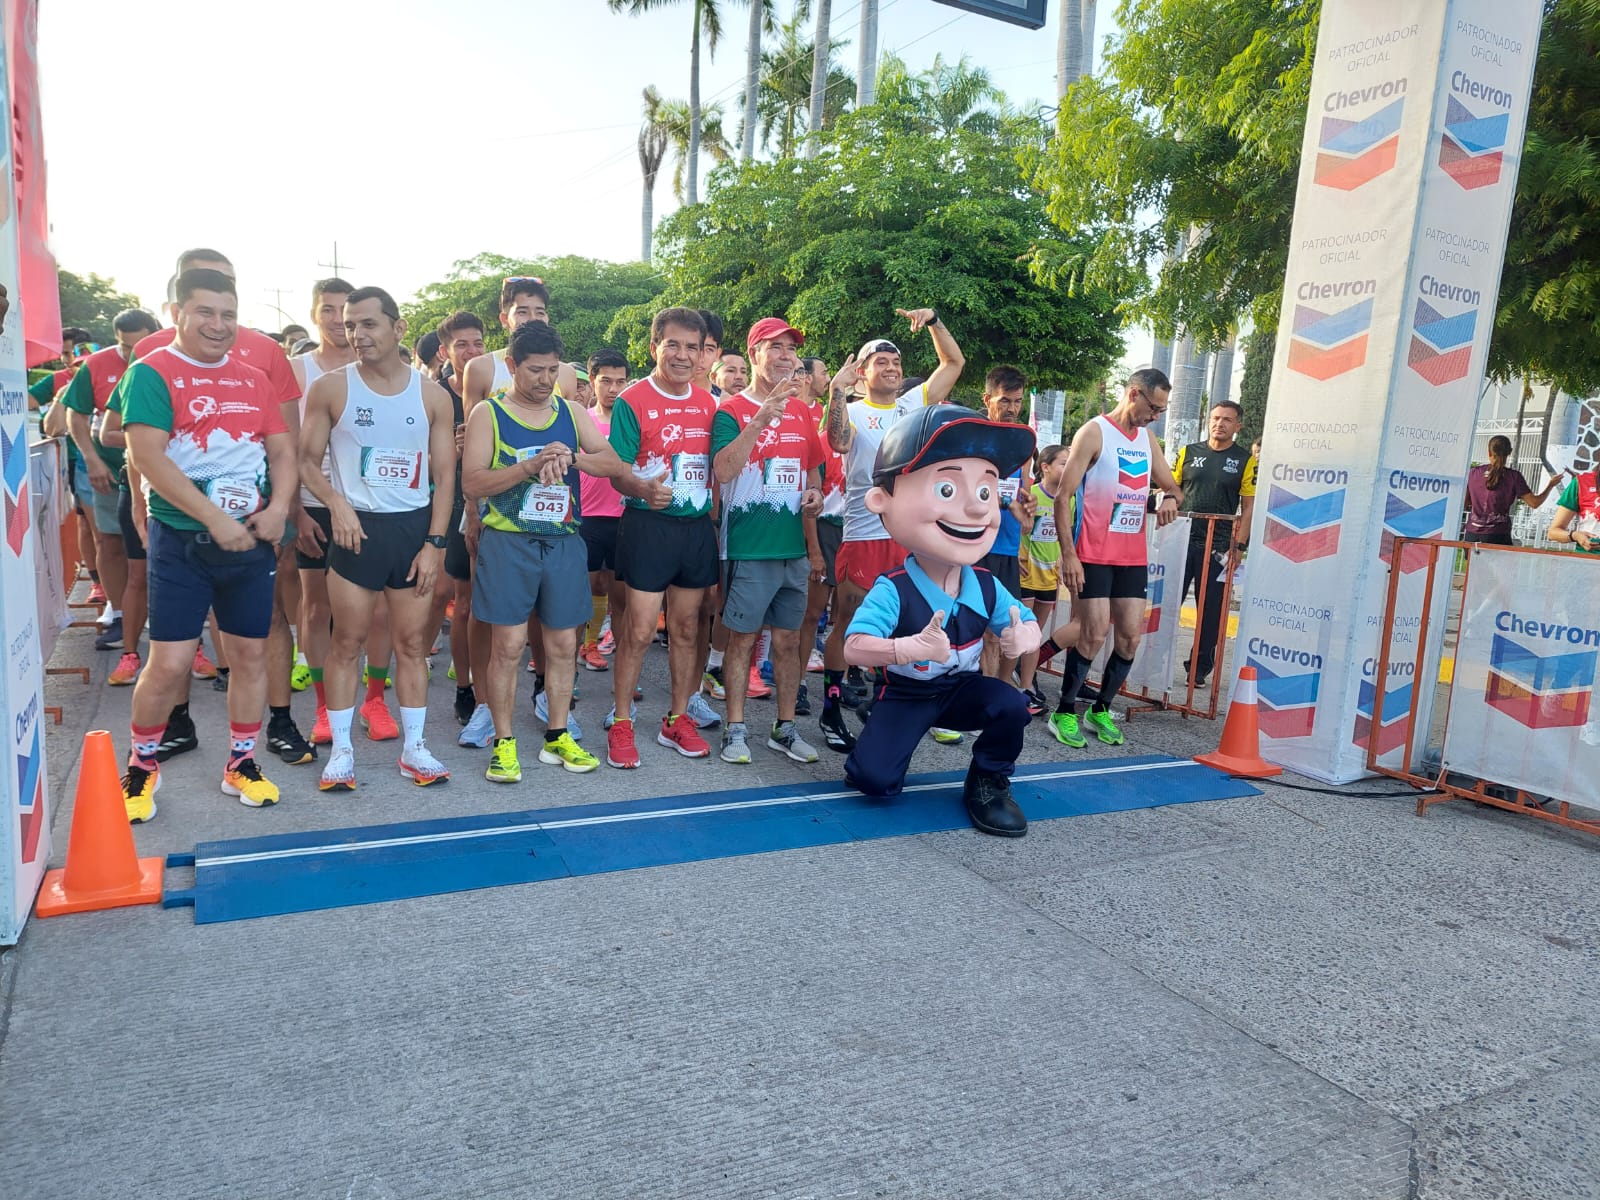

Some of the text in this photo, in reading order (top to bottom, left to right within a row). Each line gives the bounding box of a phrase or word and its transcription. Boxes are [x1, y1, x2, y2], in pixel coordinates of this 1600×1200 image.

[1328, 24, 1419, 61] PATROCINADOR
[1456, 20, 1522, 55] PATROCINADOR
[1347, 51, 1391, 72] OFICIAL
[1471, 45, 1504, 67] OFICIAL
[1324, 77, 1407, 112] Chevron
[1451, 70, 1512, 109] Chevron
[1301, 228, 1387, 251] PATROCINADOR
[1425, 227, 1490, 254] PATROCINADOR
[1319, 250, 1361, 265] OFICIAL
[1438, 250, 1471, 267] OFICIAL
[1297, 279, 1377, 302] Chevron
[1419, 274, 1480, 305] Chevron
[1276, 422, 1358, 434] PATROCINADOR
[1394, 425, 1459, 444] PATROCINADOR
[1293, 438, 1333, 450] OFICIAL
[1408, 444, 1441, 459] OFICIAL
[378, 466, 409, 478] 055
[685, 471, 704, 481] 016
[776, 474, 795, 484] 110
[1271, 463, 1348, 485] Chevron
[1389, 470, 1450, 494] Chevron
[220, 496, 249, 511] 162
[536, 501, 564, 513] 043
[1041, 528, 1056, 536] 06
[1252, 597, 1331, 621] PATROCINADOR
[1268, 616, 1307, 633] OFICIAL
[1495, 611, 1600, 647] Chevron
[1391, 632, 1413, 643] ICIAL
[1248, 637, 1322, 669] Chevron
